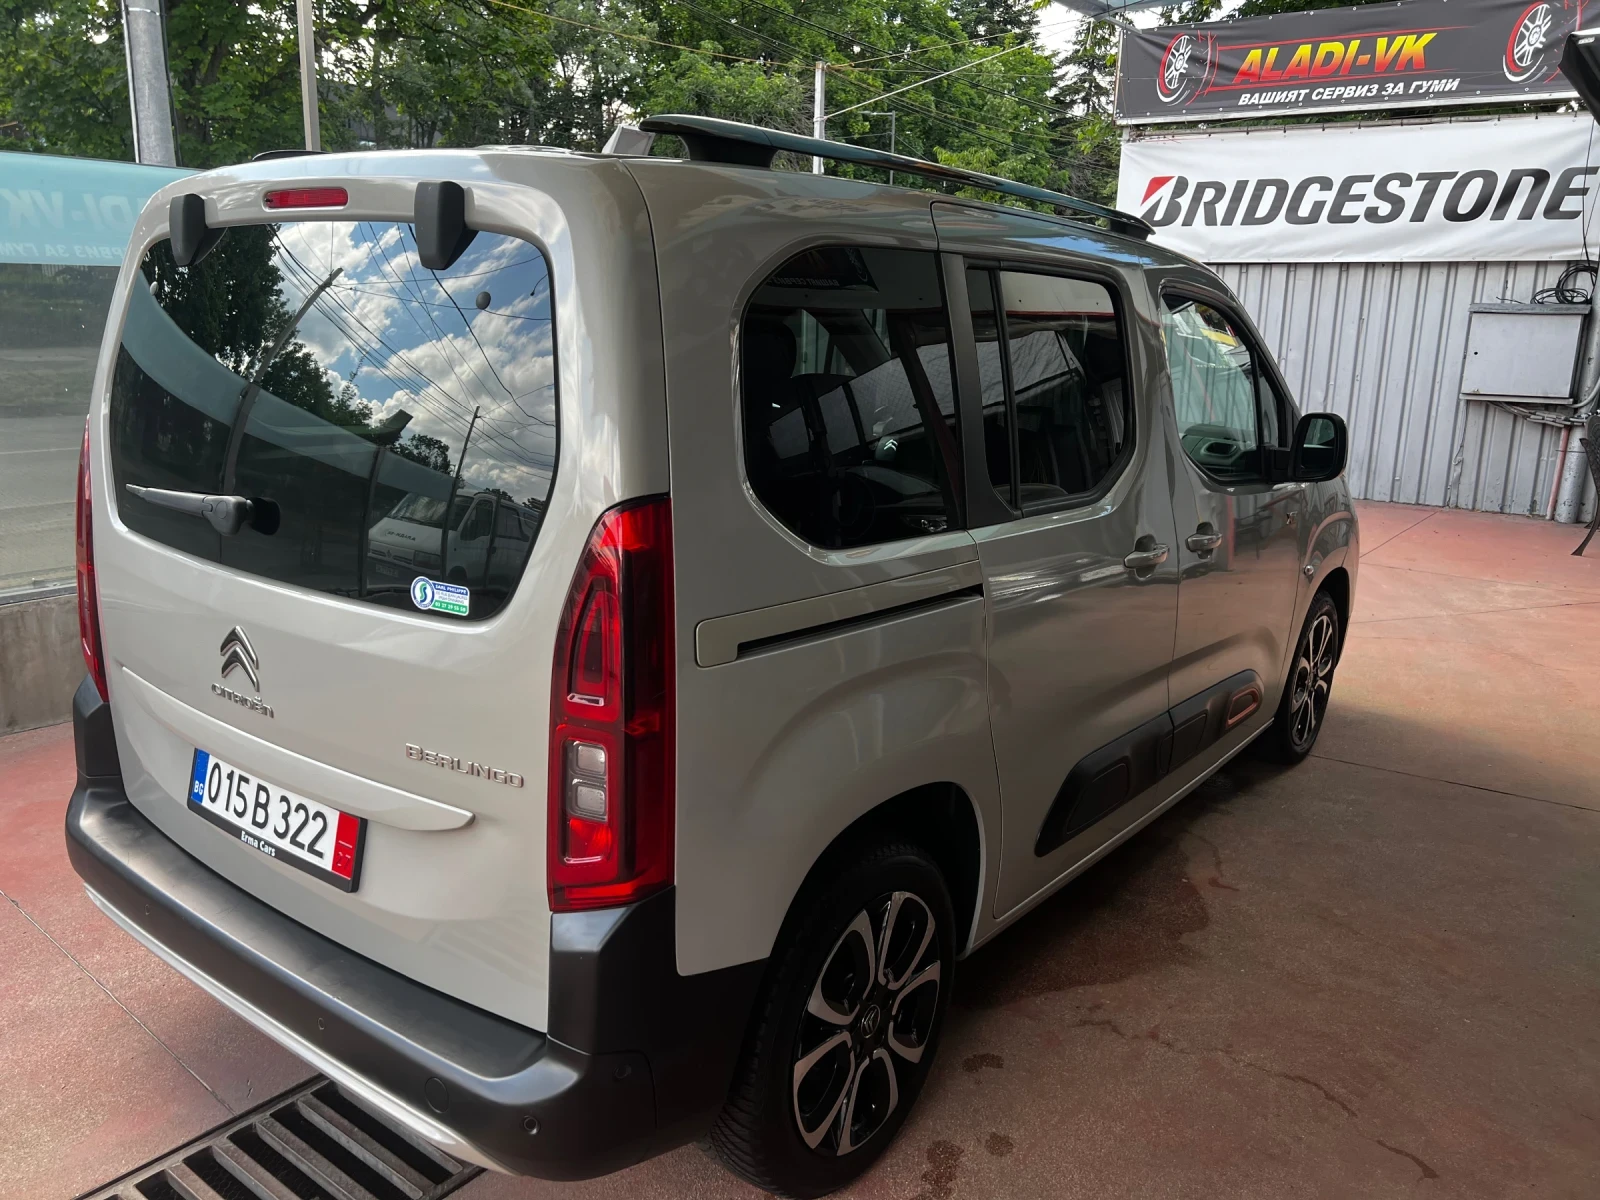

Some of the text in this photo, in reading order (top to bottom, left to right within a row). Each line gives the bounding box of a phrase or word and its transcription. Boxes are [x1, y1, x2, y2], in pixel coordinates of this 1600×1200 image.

[1232, 32, 1437, 84] ALADI-VK
[1238, 78, 1460, 106] ВАШИЯТ СЕРВИЗ ЗА ГУМИ
[1141, 165, 1600, 227] BRIDGESTONE
[211, 682, 275, 719] CITROËN
[405, 743, 524, 788] BERLINGO
[193, 780, 204, 796] BG
[241, 830, 276, 857] Erma Cars
